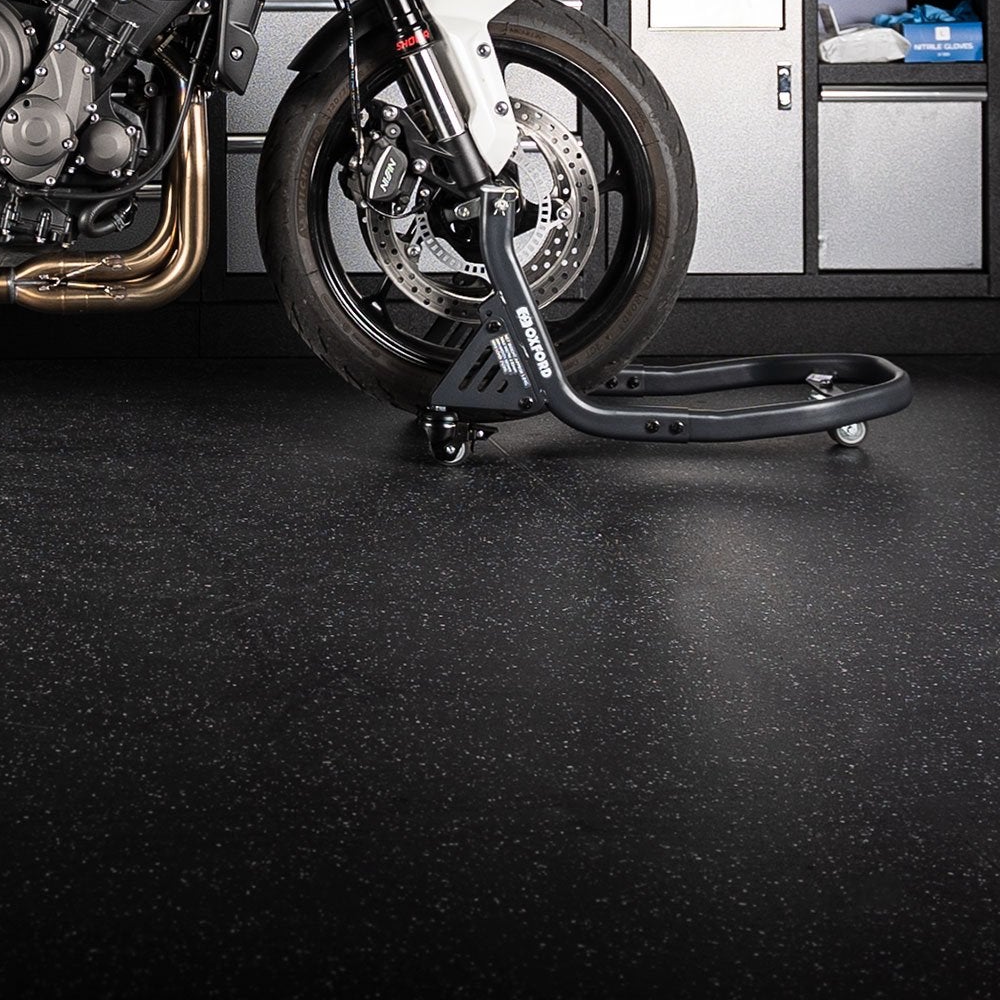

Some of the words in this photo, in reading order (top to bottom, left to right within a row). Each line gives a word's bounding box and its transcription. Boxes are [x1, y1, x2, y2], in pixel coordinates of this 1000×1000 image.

[395, 29, 430, 51] SHOA
[913, 43, 942, 51] NITRILE
[943, 42, 974, 50] GLOVES
[524, 326, 552, 379] OXFORD
